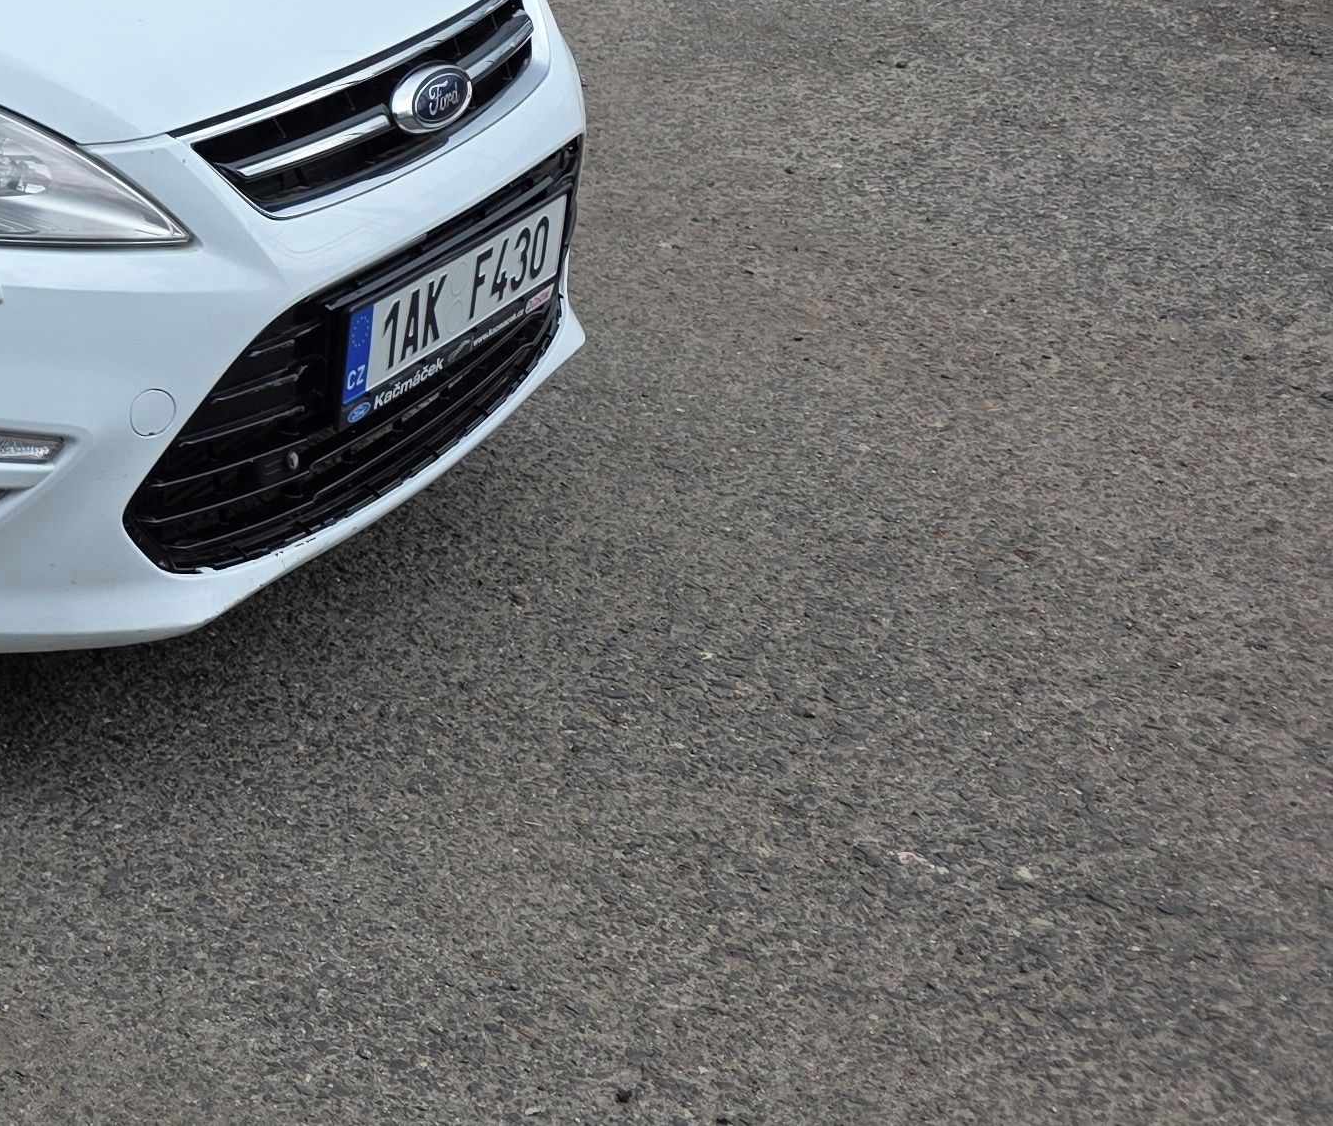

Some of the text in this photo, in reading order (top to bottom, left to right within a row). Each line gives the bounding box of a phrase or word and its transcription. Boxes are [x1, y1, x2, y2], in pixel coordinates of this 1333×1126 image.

[428, 80, 459, 116] Ford
[381, 215, 550, 371] 1AK F430
[346, 363, 366, 391] CZ
[373, 357, 445, 411] Kačmáček
